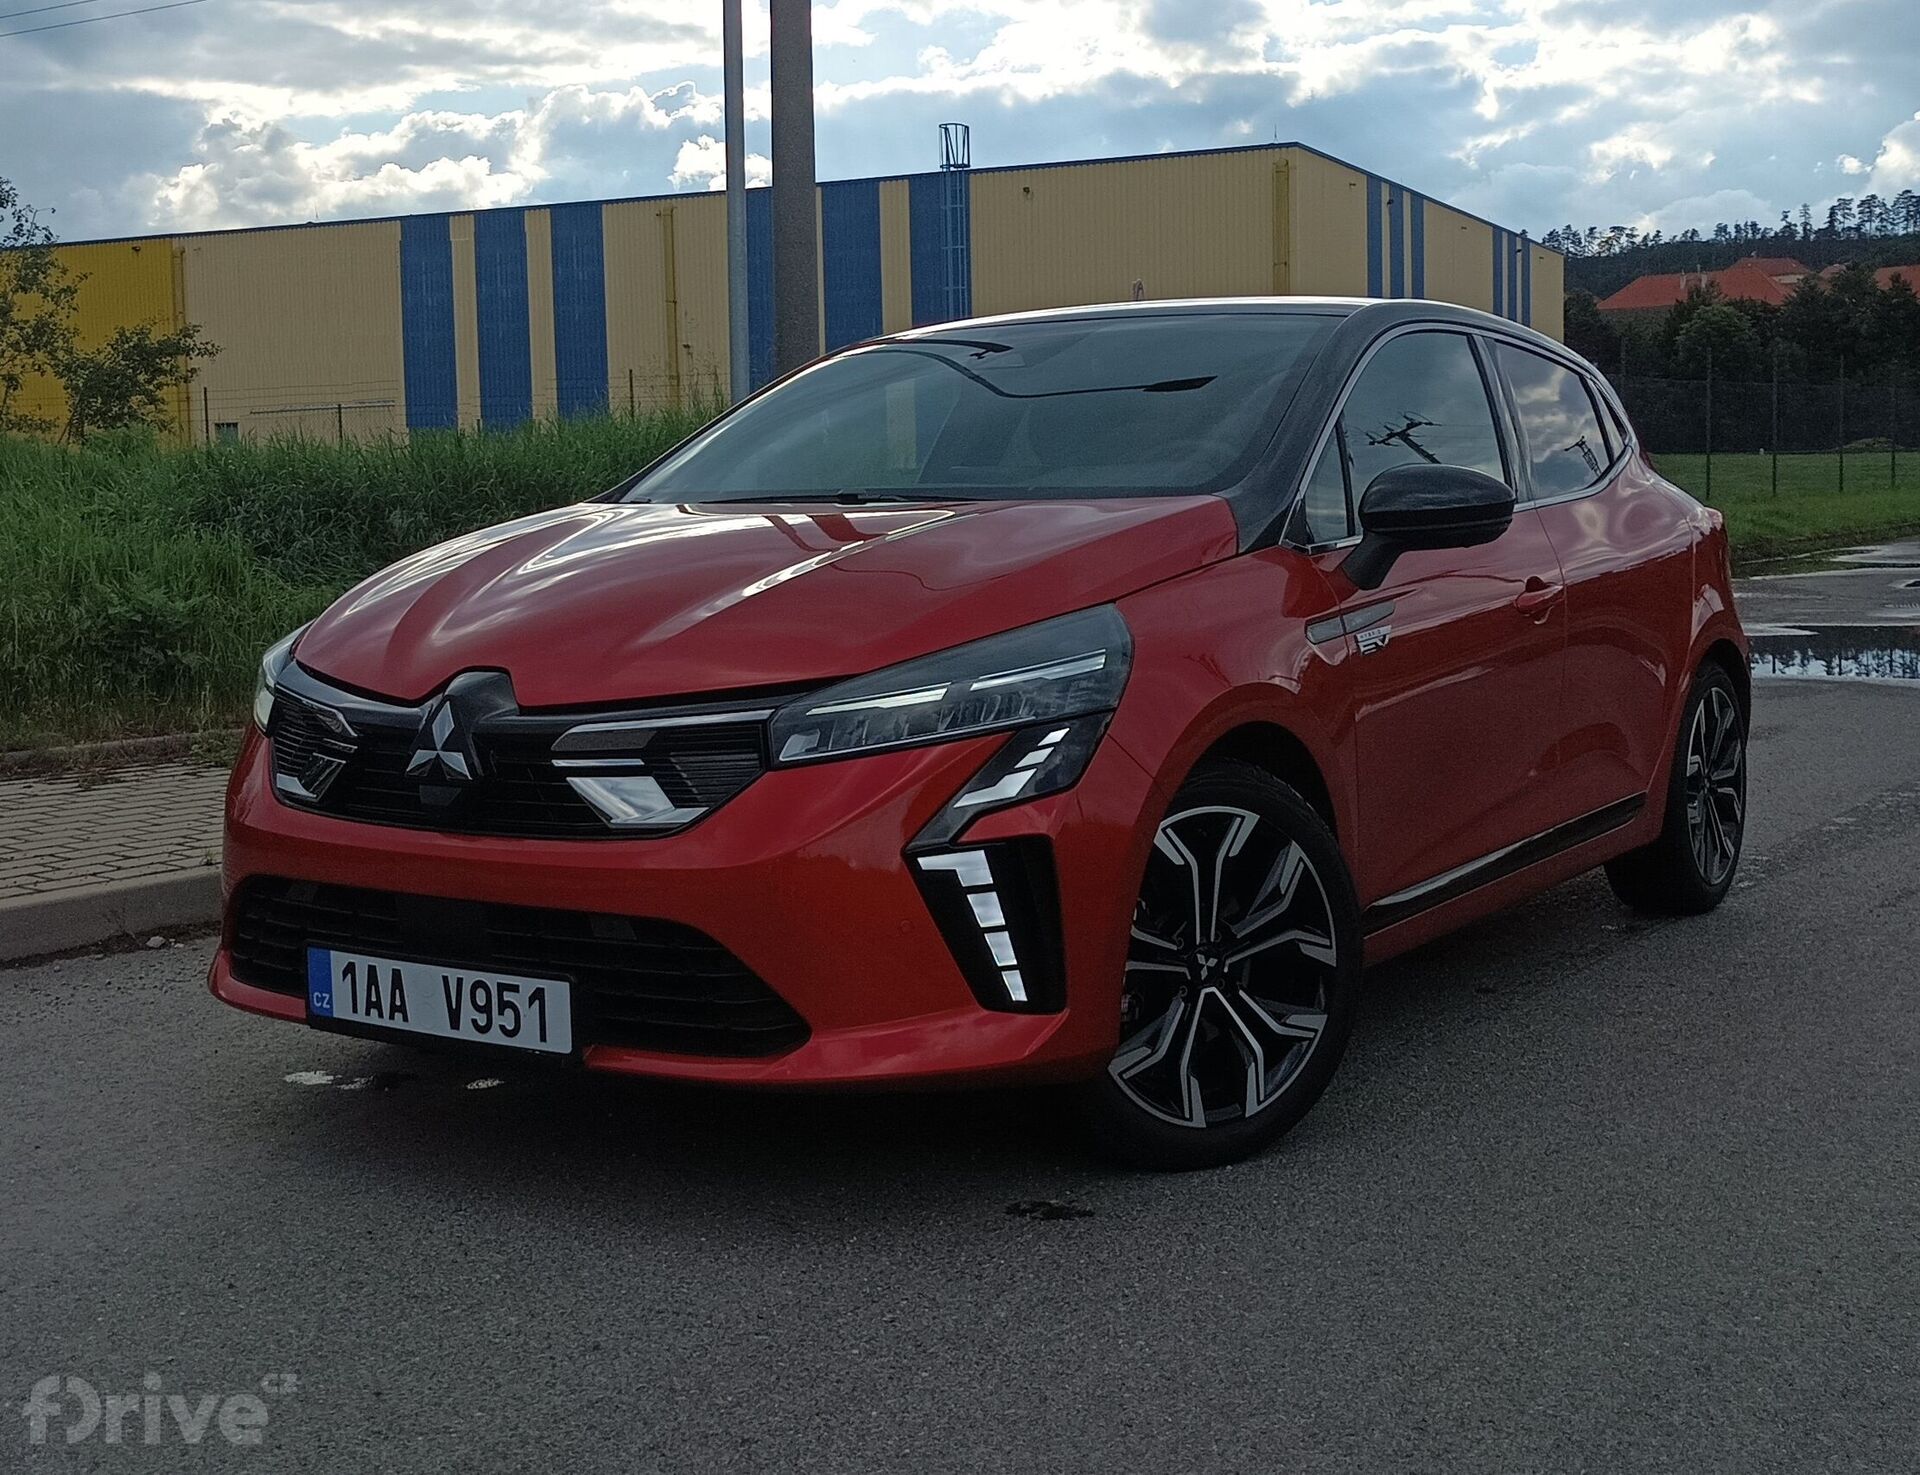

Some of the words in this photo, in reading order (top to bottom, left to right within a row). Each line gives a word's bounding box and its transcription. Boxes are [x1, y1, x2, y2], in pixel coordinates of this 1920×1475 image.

[313, 991, 330, 1009] CZ
[341, 961, 409, 1023] 1AA
[441, 974, 548, 1043] V951
